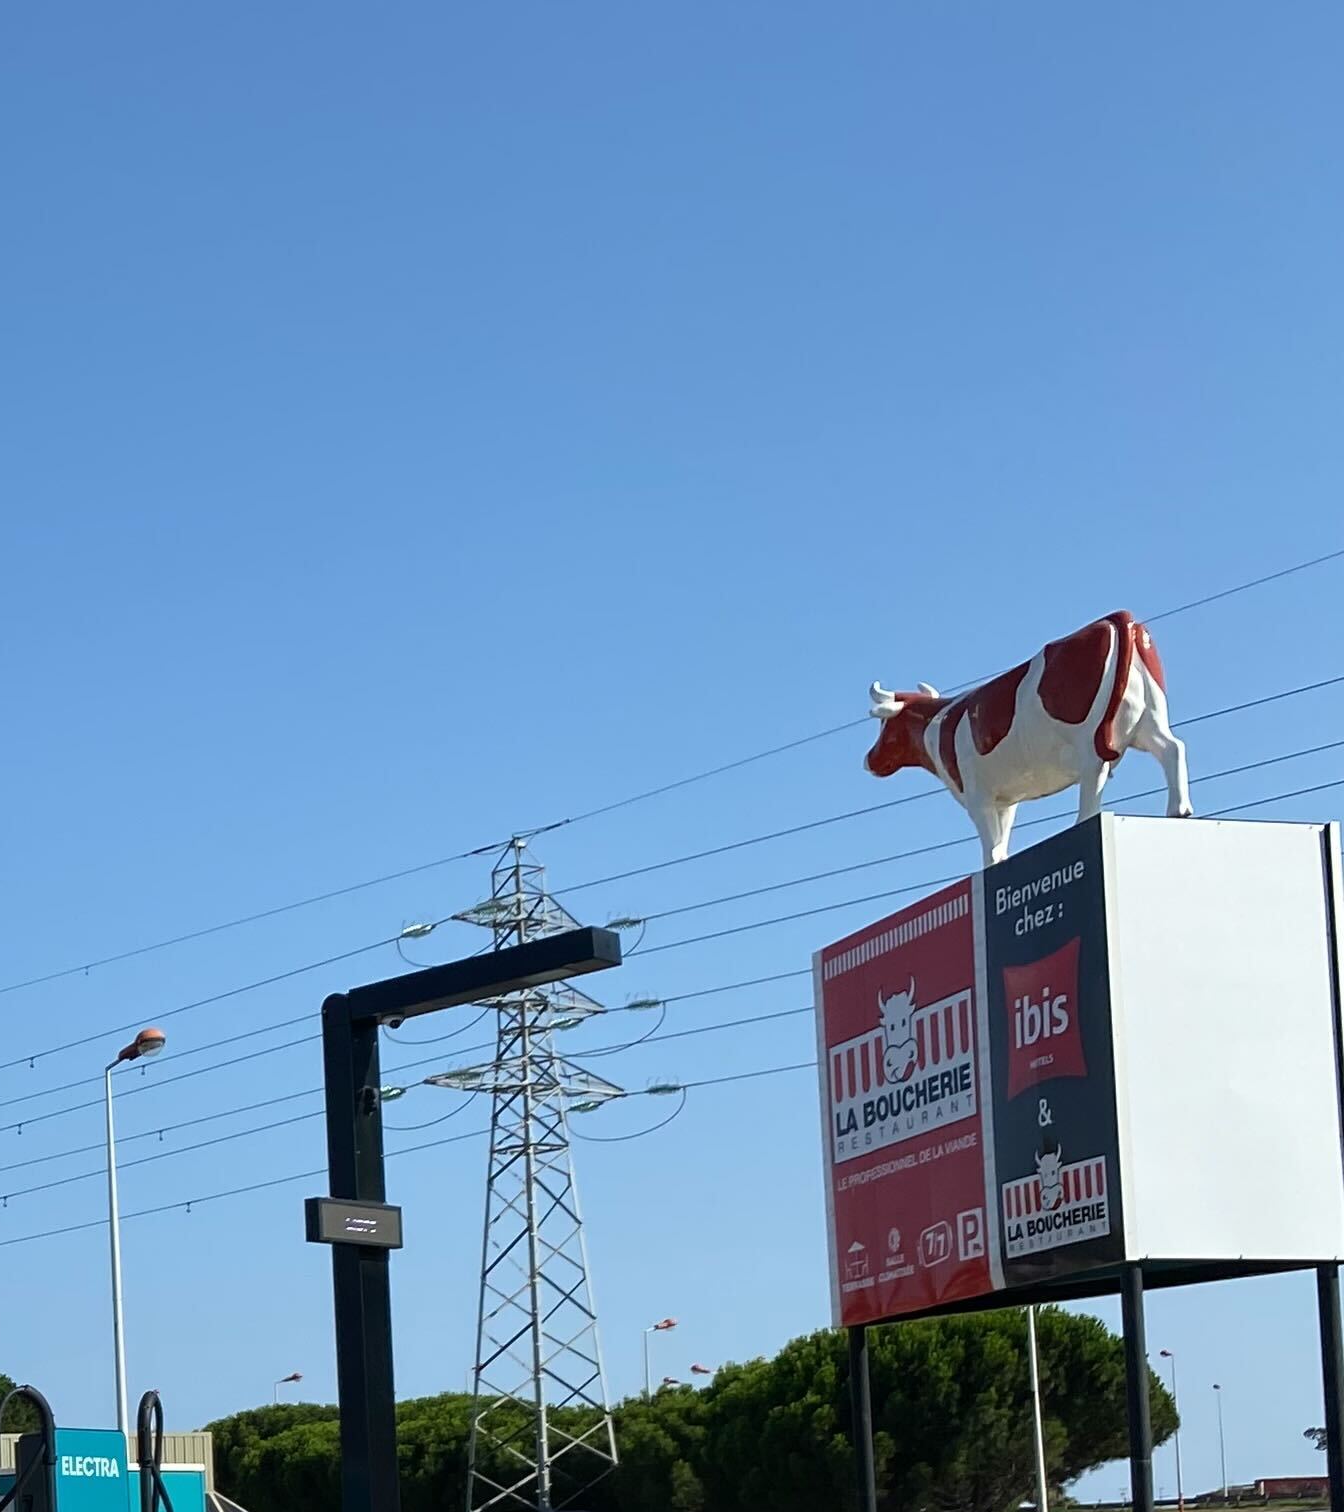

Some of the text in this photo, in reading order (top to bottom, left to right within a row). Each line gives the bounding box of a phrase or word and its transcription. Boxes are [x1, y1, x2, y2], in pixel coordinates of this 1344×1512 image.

[995, 859, 1085, 915] Bienvenue
[1014, 903, 1054, 936] chez
[1014, 987, 1069, 1049] ibis
[836, 1061, 973, 1137] LA BOUCHERIE
[837, 1093, 974, 1153] RESTAURANT
[1038, 1098, 1053, 1127] &
[837, 1132, 978, 1191] LE PROFESSIONNEL DE LA VIANDE
[1008, 1201, 1106, 1242] LA BOUCHERIE
[62, 1455, 120, 1478] ELECTRA
